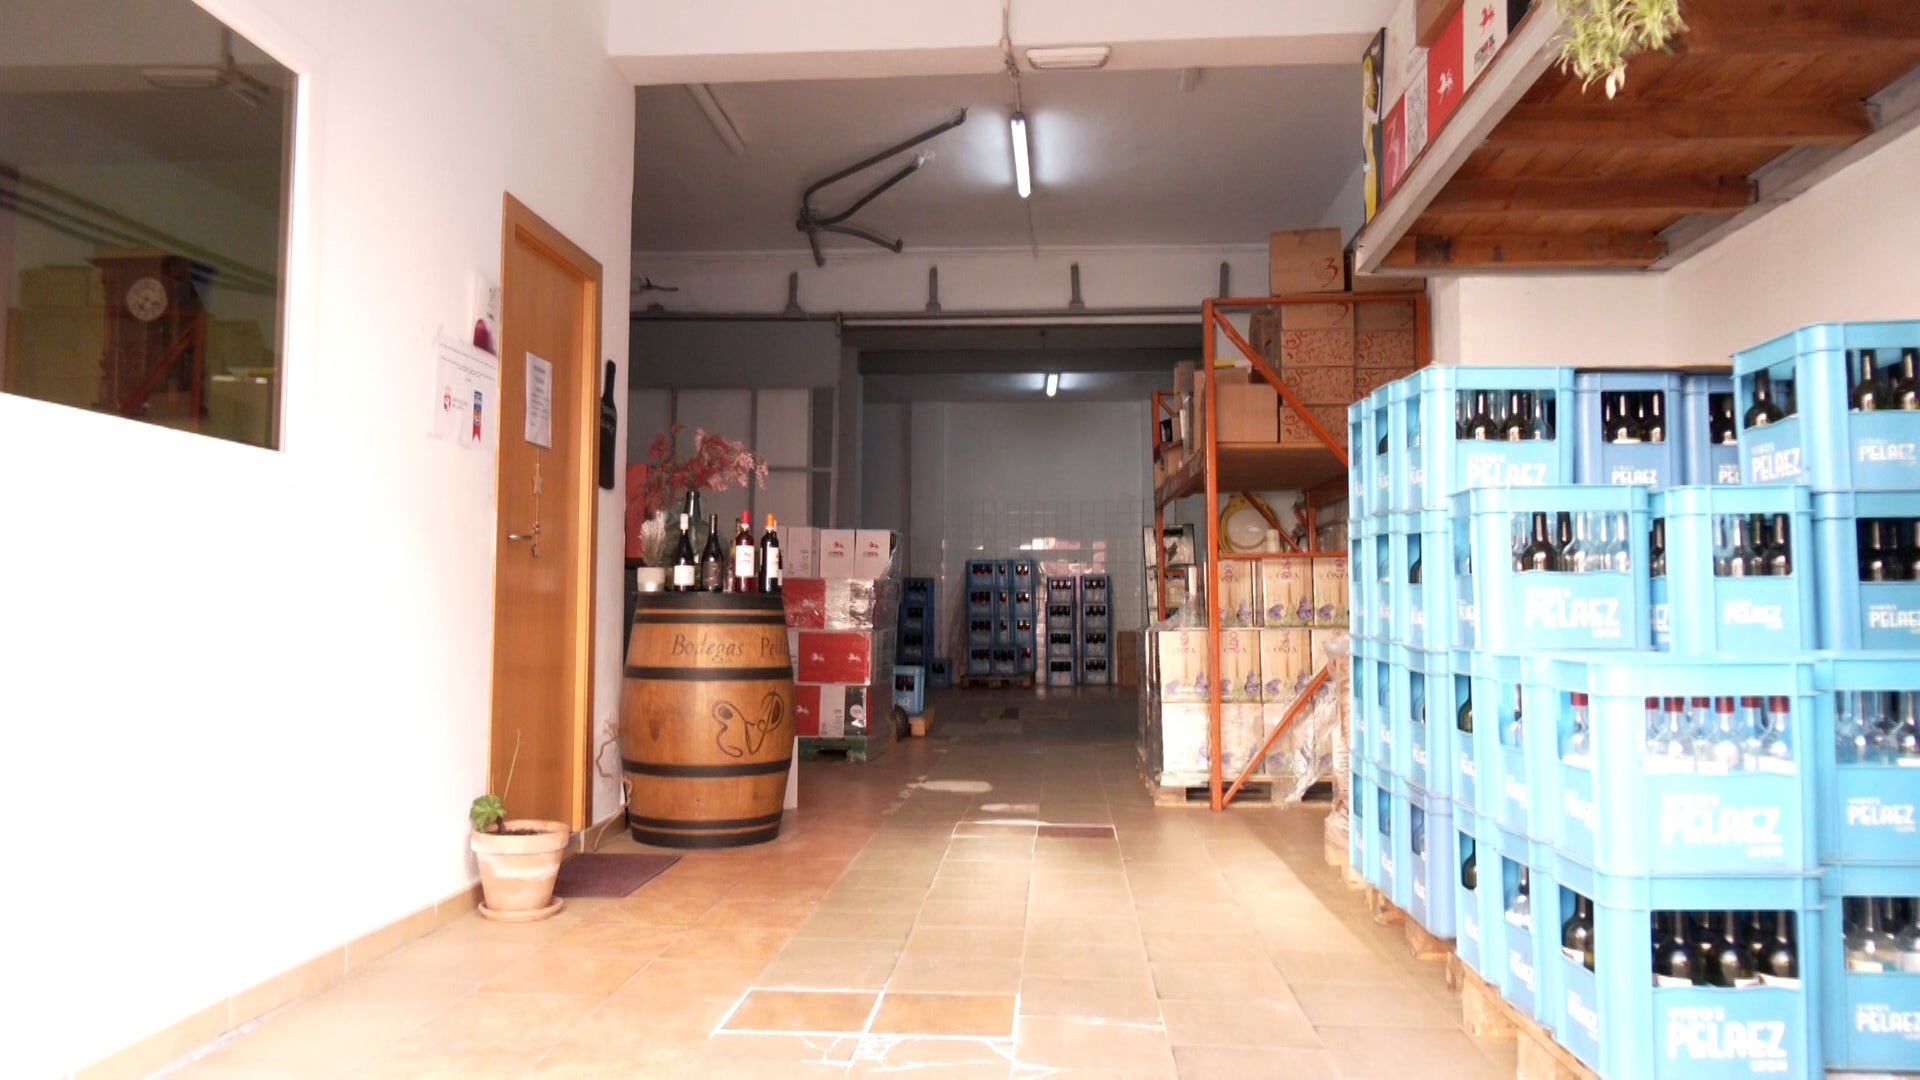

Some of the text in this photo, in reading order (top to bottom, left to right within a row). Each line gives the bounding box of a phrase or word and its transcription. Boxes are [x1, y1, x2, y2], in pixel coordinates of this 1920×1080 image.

[1321, 256, 1339, 288] 3
[1751, 446, 1802, 483] PELAEZ
[1858, 443, 1916, 462] PELAEZ
[1465, 462, 1548, 488] PELAEZ
[1611, 469, 1658, 485] PELAEZ
[1718, 470, 1741, 484] PEL
[1524, 597, 1621, 629] PELAEZ
[1869, 611, 1920, 629] PELAE
[671, 632, 745, 664] Bodegas
[1660, 805, 1784, 845] PELAEZ
[1846, 804, 1916, 826] PELAEZ
[1665, 1020, 1788, 1060] PELAEZ
